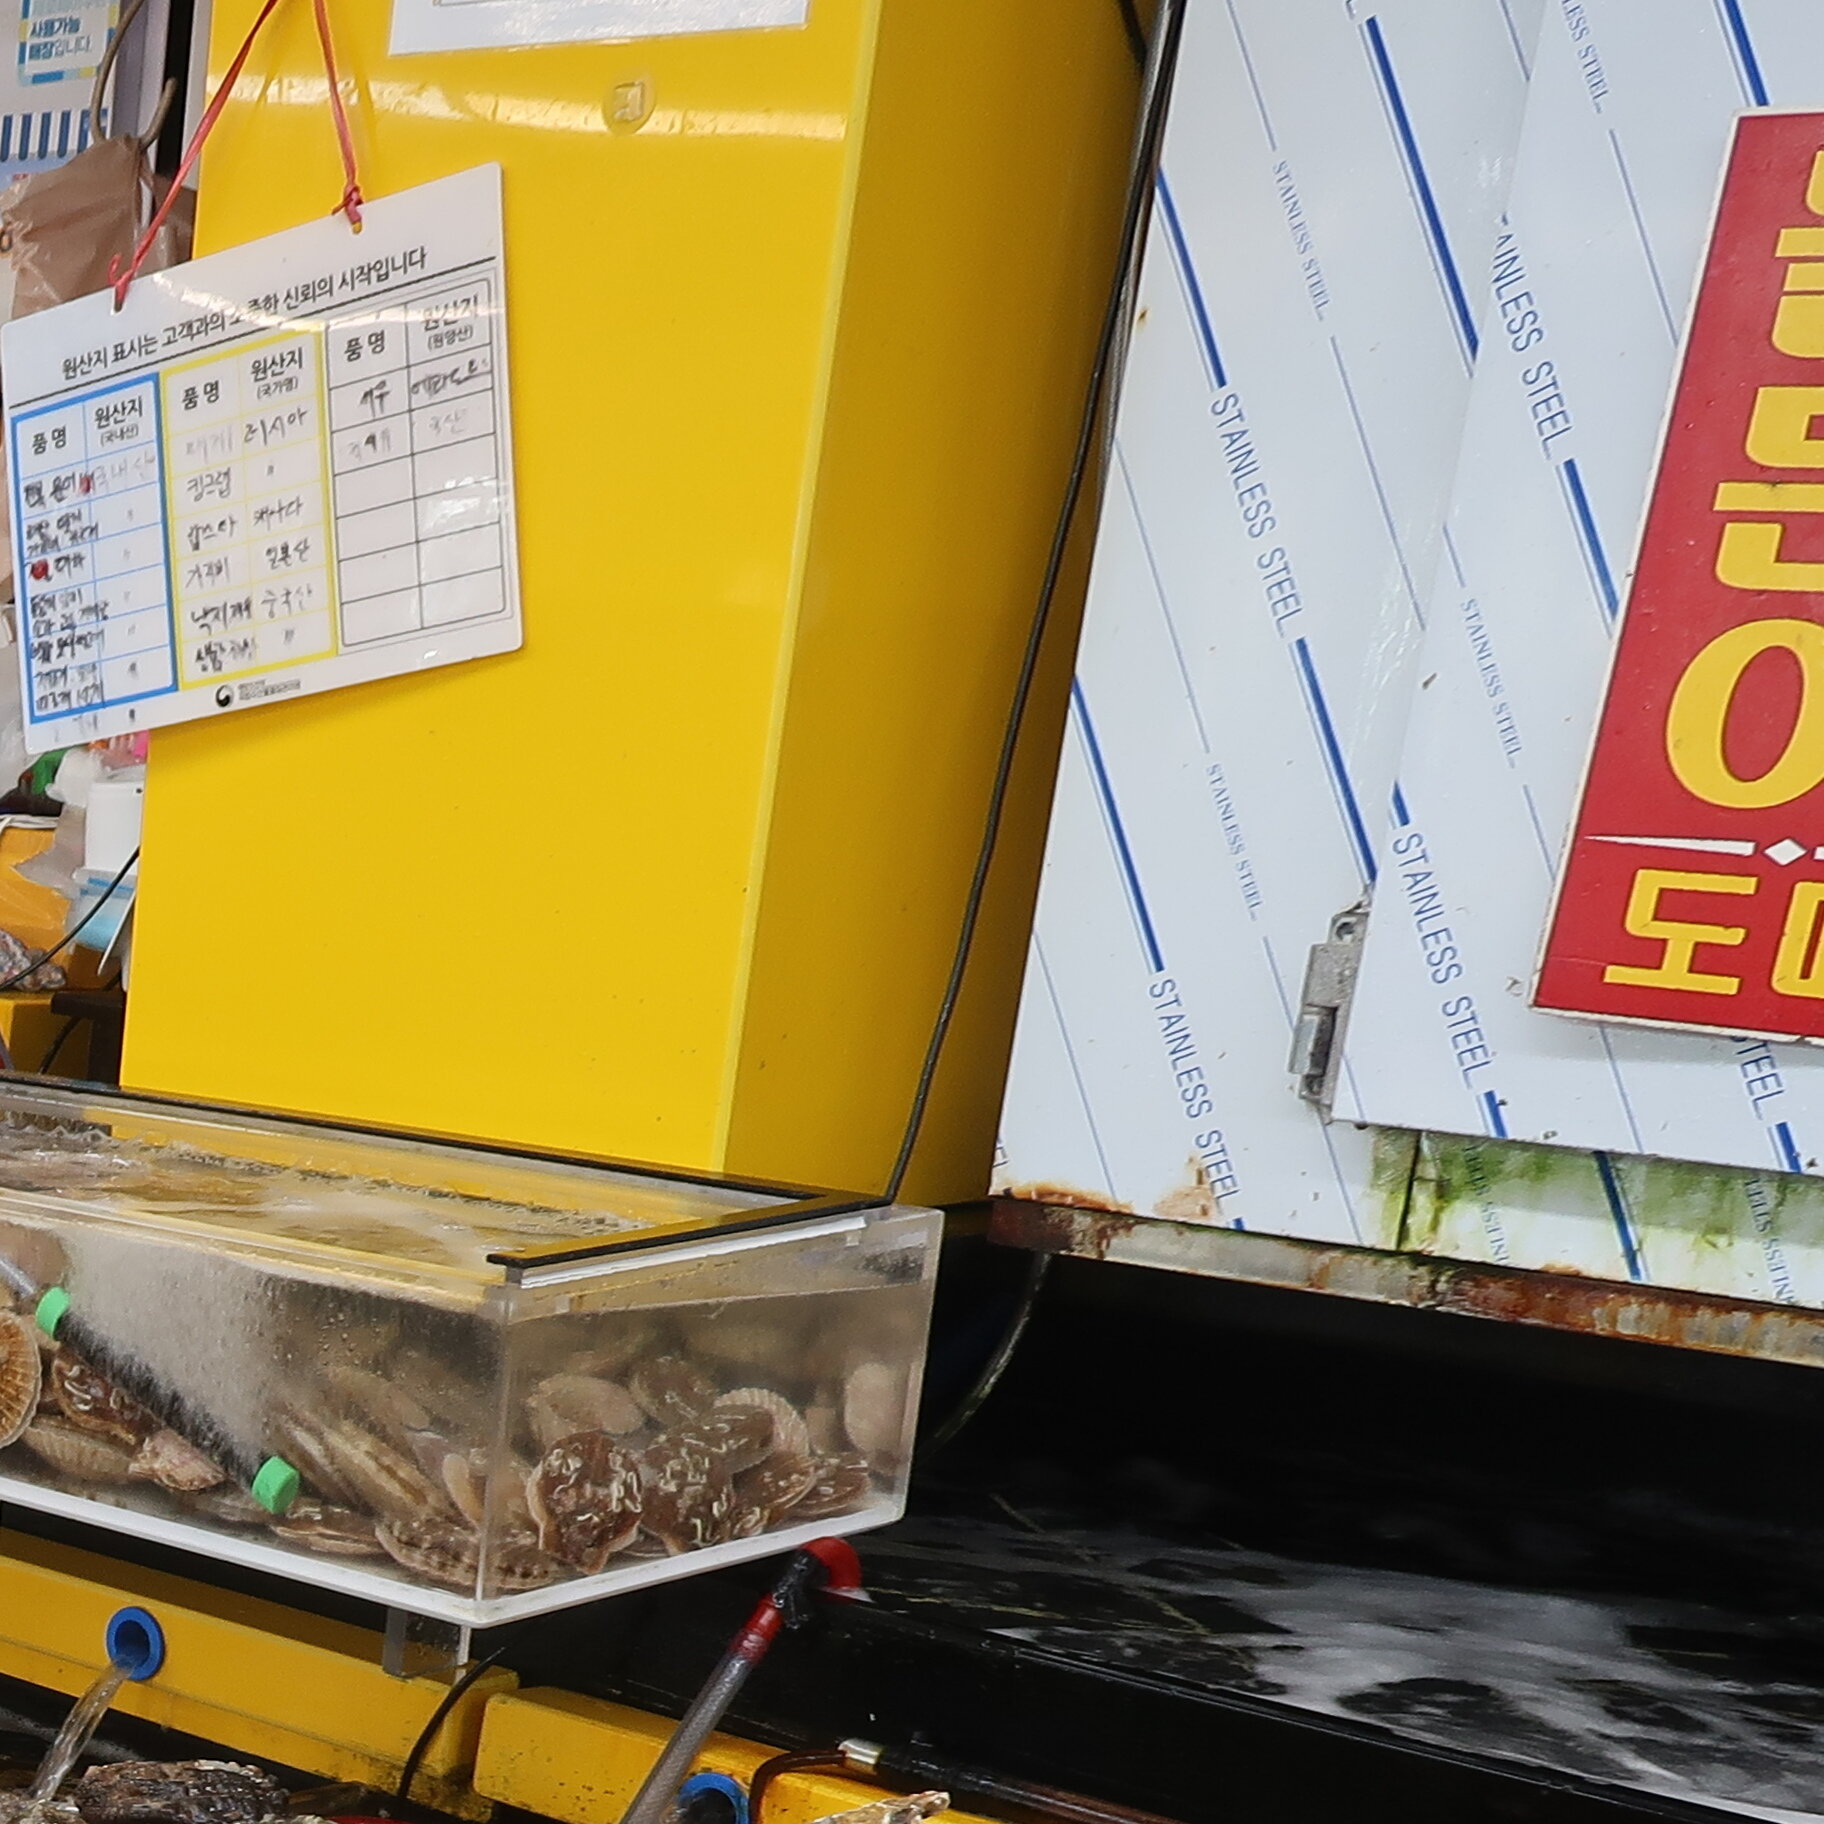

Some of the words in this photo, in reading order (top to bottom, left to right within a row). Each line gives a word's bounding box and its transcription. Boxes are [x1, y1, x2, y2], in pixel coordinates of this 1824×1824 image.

[282, 273, 334, 312] 신뢰의
[336, 244, 429, 295] 시작입니다
[1272, 159, 1315, 256] STAINLESS
[1301, 256, 1331, 323] STEEL
[62, 346, 108, 382] 원산지
[110, 330, 158, 366] 표시는
[161, 308, 226, 350] 고객과의
[94, 394, 143, 430] 원산지
[250, 346, 303, 383] 원산지
[1491, 211, 1545, 355] AINLESS
[1521, 360, 1574, 462] STEEL
[1211, 391, 1277, 541] STAINLESS
[1257, 546, 1305, 640] STEEL
[1459, 596, 1506, 701] STAINLESS
[1491, 701, 1524, 770] STEEL
[1206, 762, 1247, 857] STAINLESS
[1235, 857, 1265, 922] STEEL
[1391, 830, 1464, 985] STAINLESS
[1441, 994, 1494, 1090] STEEL
[1148, 976, 1214, 1121] STAINLESS
[1194, 1128, 1242, 1215] STEEL
